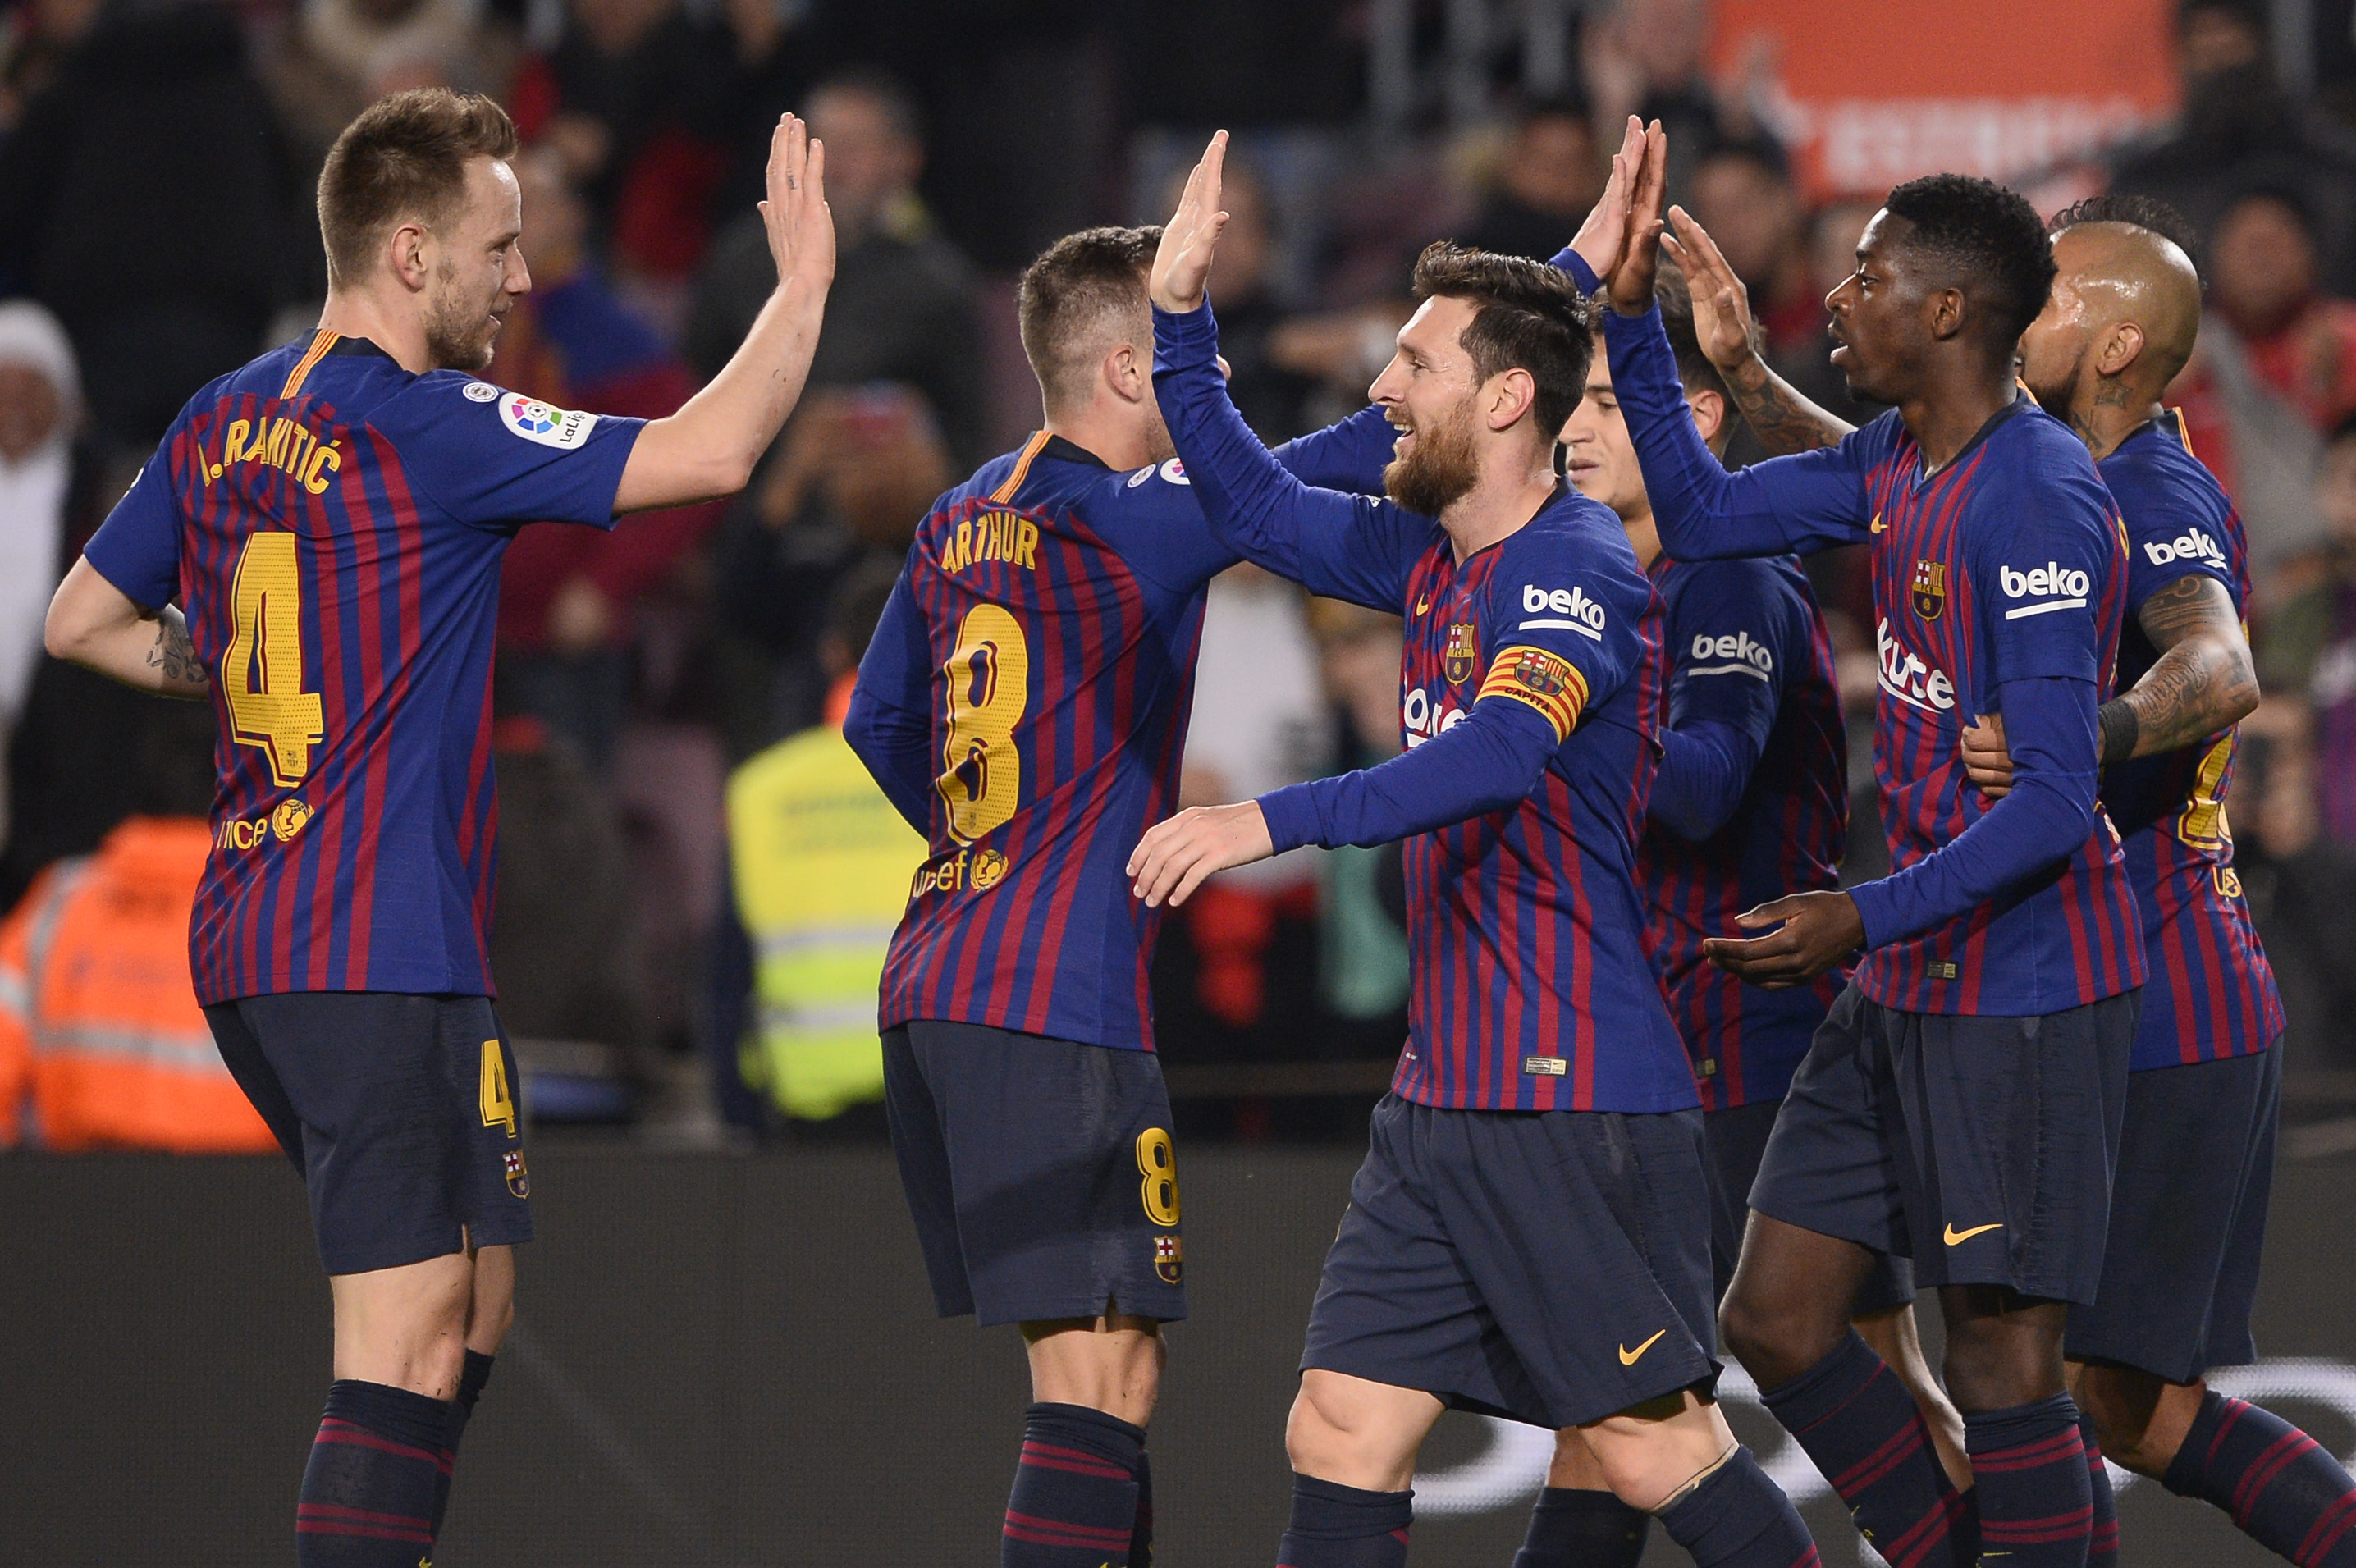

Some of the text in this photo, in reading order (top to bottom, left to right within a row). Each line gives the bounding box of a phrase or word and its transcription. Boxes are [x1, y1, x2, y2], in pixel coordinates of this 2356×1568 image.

[559, 412, 586, 442] LaLig
[942, 511, 1039, 574] ARTHUR
[1523, 584, 1606, 631] beko
[2000, 561, 2090, 598] beko
[222, 532, 323, 788] 4
[1691, 630, 1773, 672] beko
[936, 604, 1028, 847] 8
[479, 1039, 517, 1136] 4
[1136, 1127, 1181, 1227] 8
